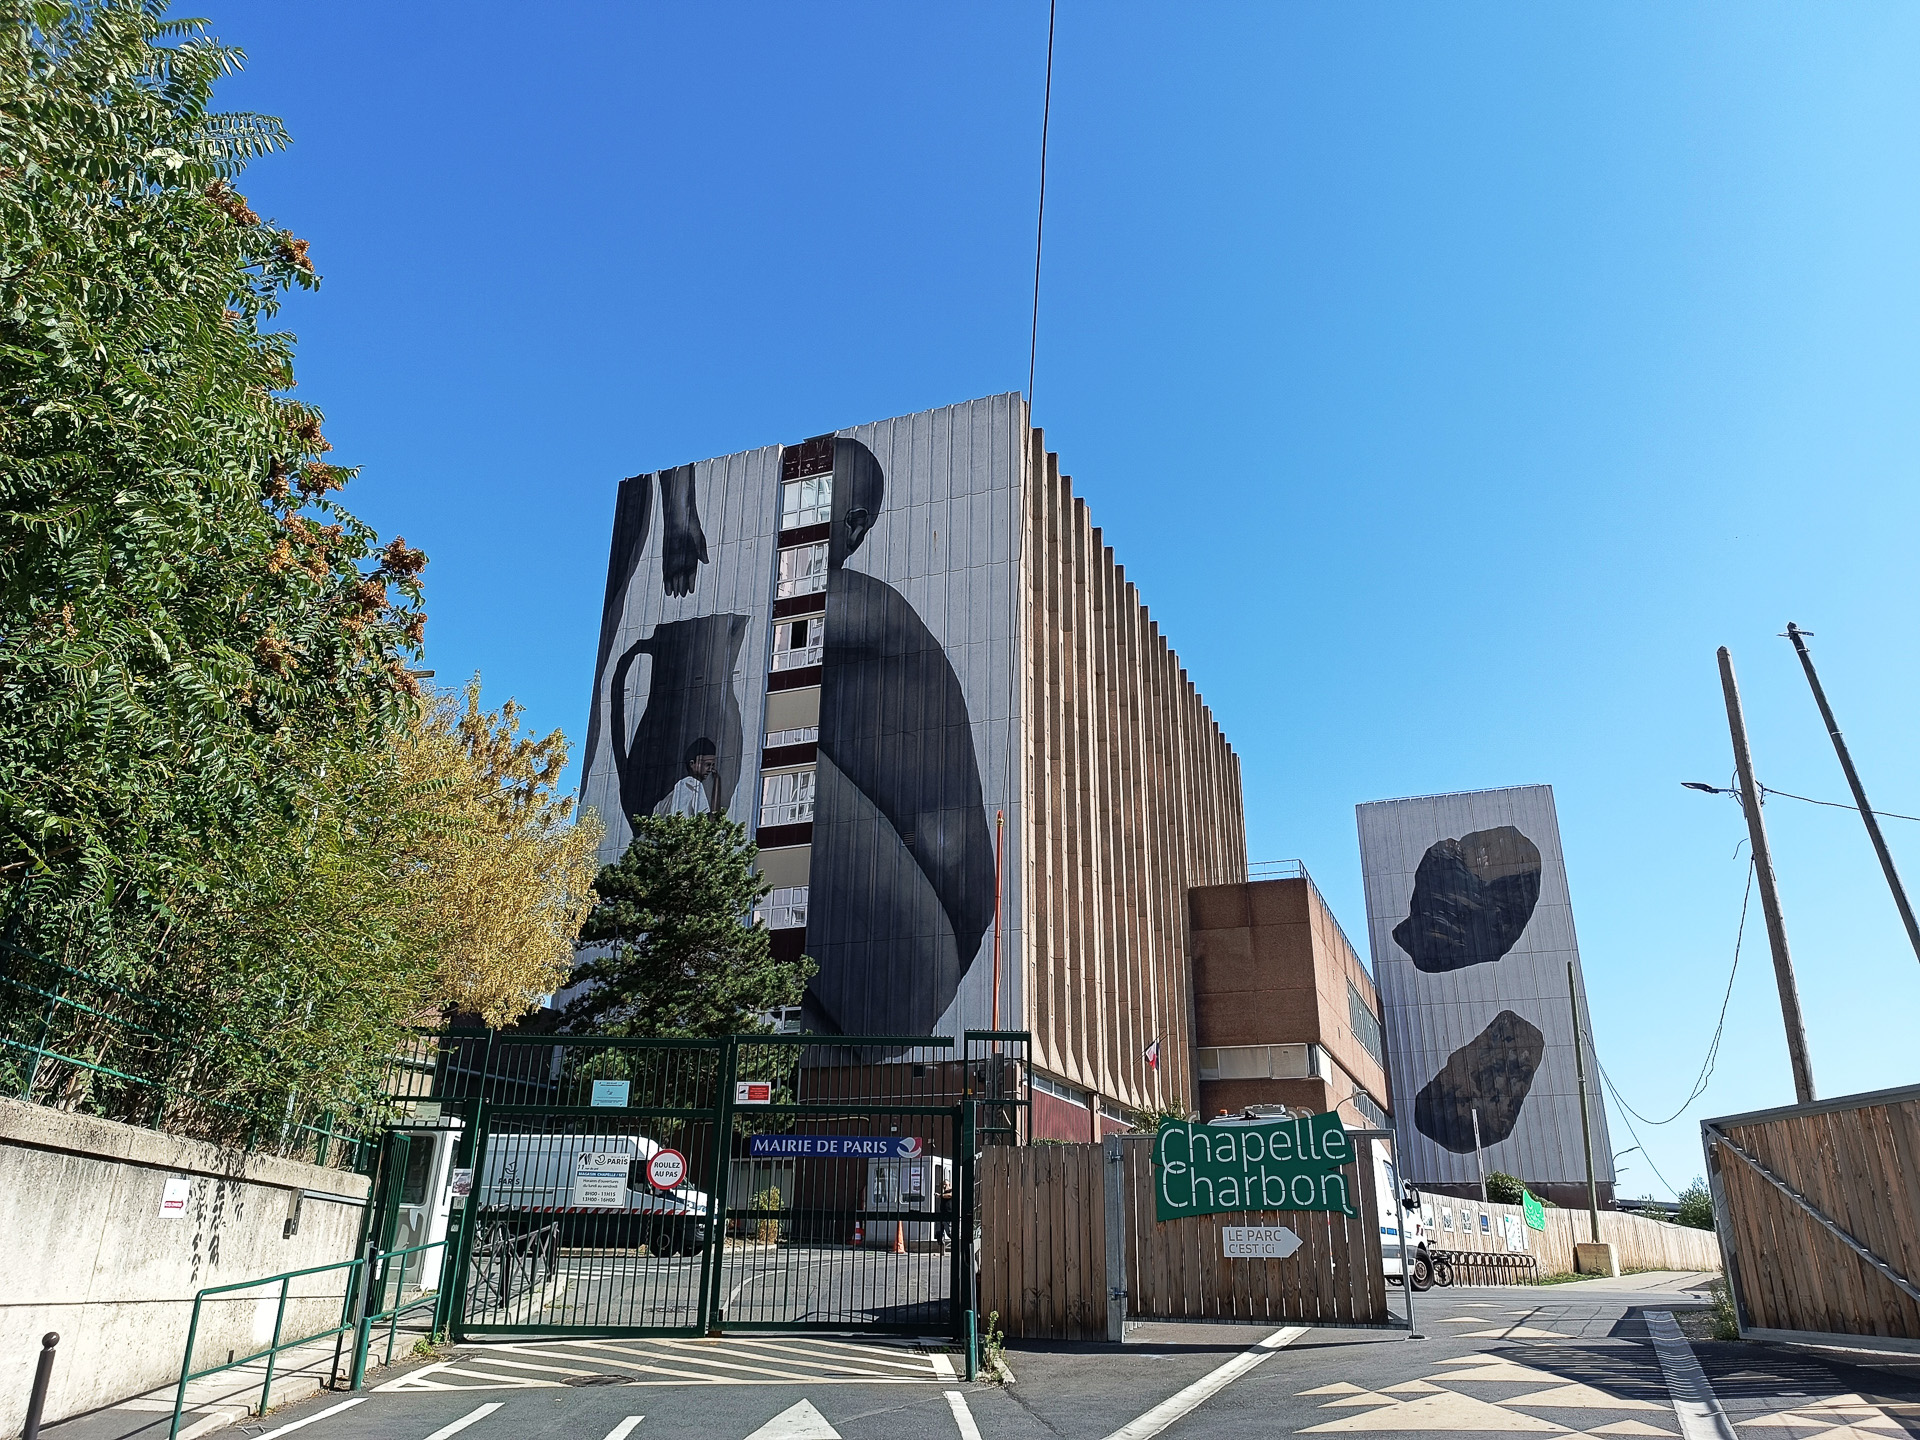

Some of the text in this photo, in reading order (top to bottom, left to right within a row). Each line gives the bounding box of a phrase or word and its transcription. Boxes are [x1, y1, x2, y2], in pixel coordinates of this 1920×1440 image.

[754, 1139, 887, 1154] MAIRIE DE PARIS
[1160, 1110, 1346, 1173] Chapelle
[653, 1161, 681, 1169] ROULEZ
[665, 1170, 678, 1178] PAS
[1162, 1161, 1354, 1215] Charbon
[1228, 1229, 1282, 1242] LE PARC
[1228, 1243, 1258, 1255] C'EST
